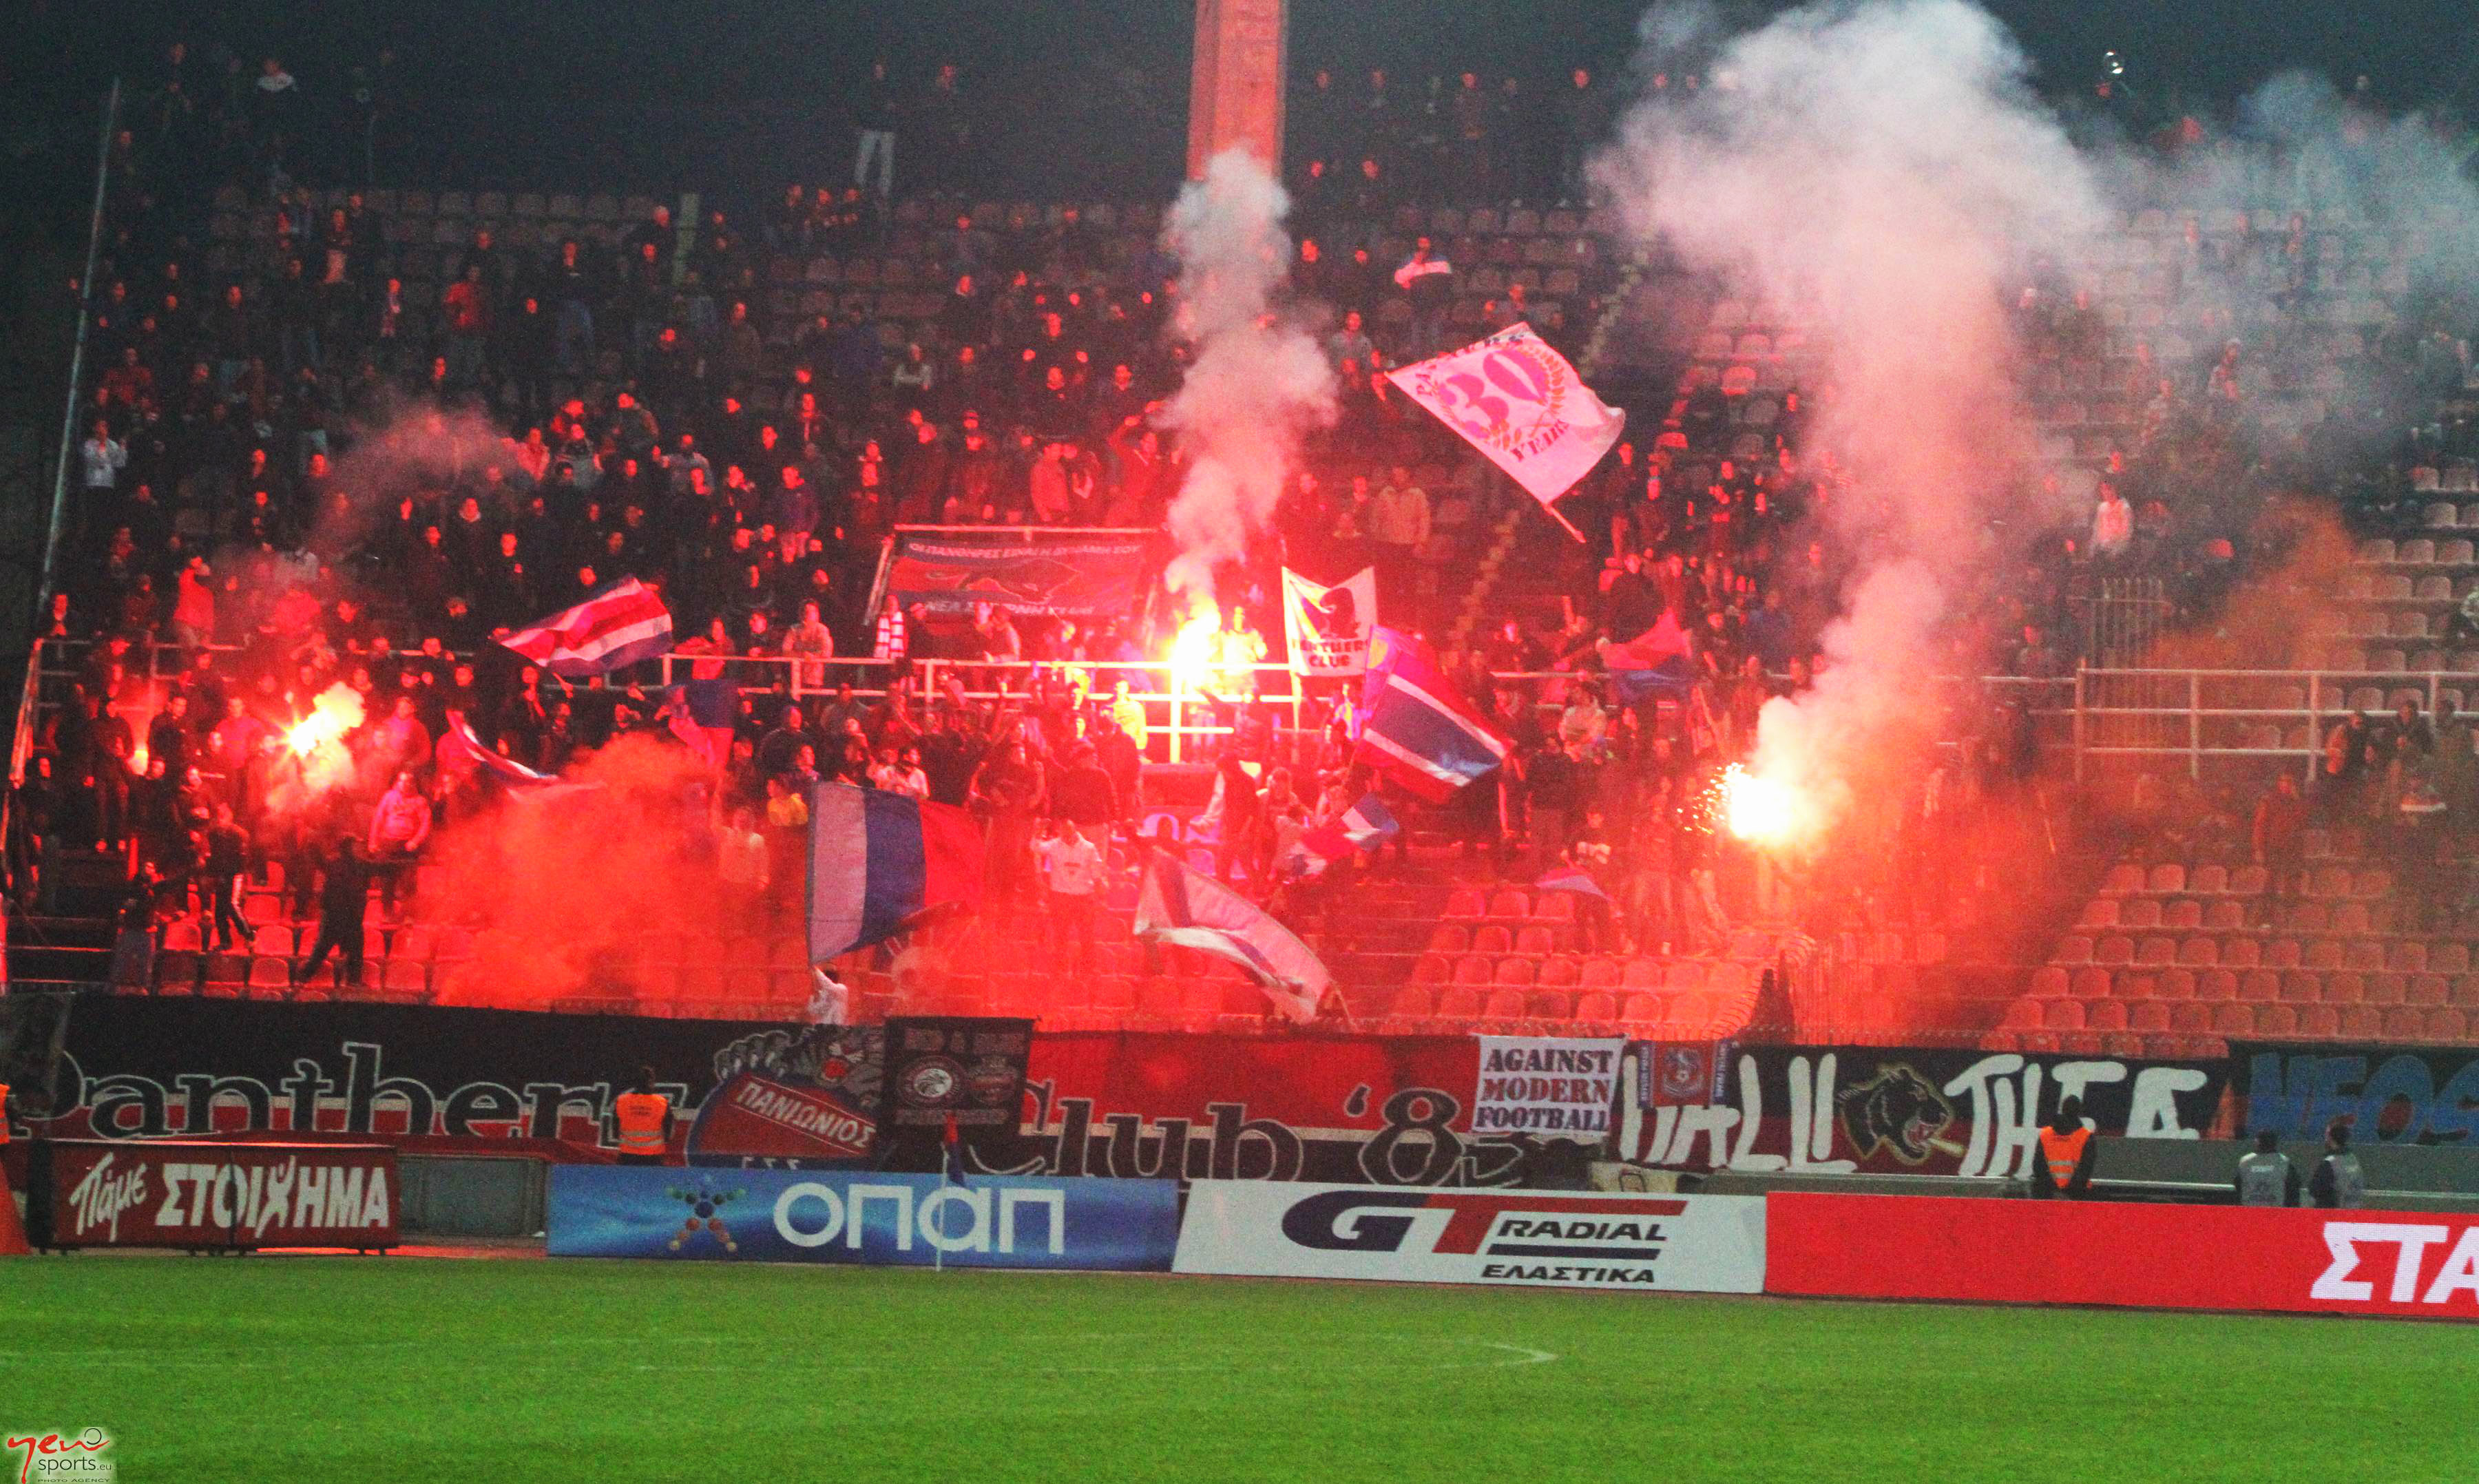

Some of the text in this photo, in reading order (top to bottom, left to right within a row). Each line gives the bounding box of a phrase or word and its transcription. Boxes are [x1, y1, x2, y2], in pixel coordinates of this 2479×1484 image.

[1439, 348, 1549, 439] 30
[1309, 655, 1350, 667] CLUB
[1485, 1049, 1613, 1073] AGAINST
[1481, 1077, 1609, 1102] MODERN
[736, 1082, 877, 1148] ΠΑΝΙΩΝΙΟΣ
[1475, 1107, 1609, 1131] FOOTBALL
[155, 1156, 390, 1239] ΣΤΟΙΧΗΜΑ
[1282, 1189, 1688, 1255] GT RADIAL
[1481, 1264, 1655, 1284] ΕΛΑΣΤΙΚΑ
